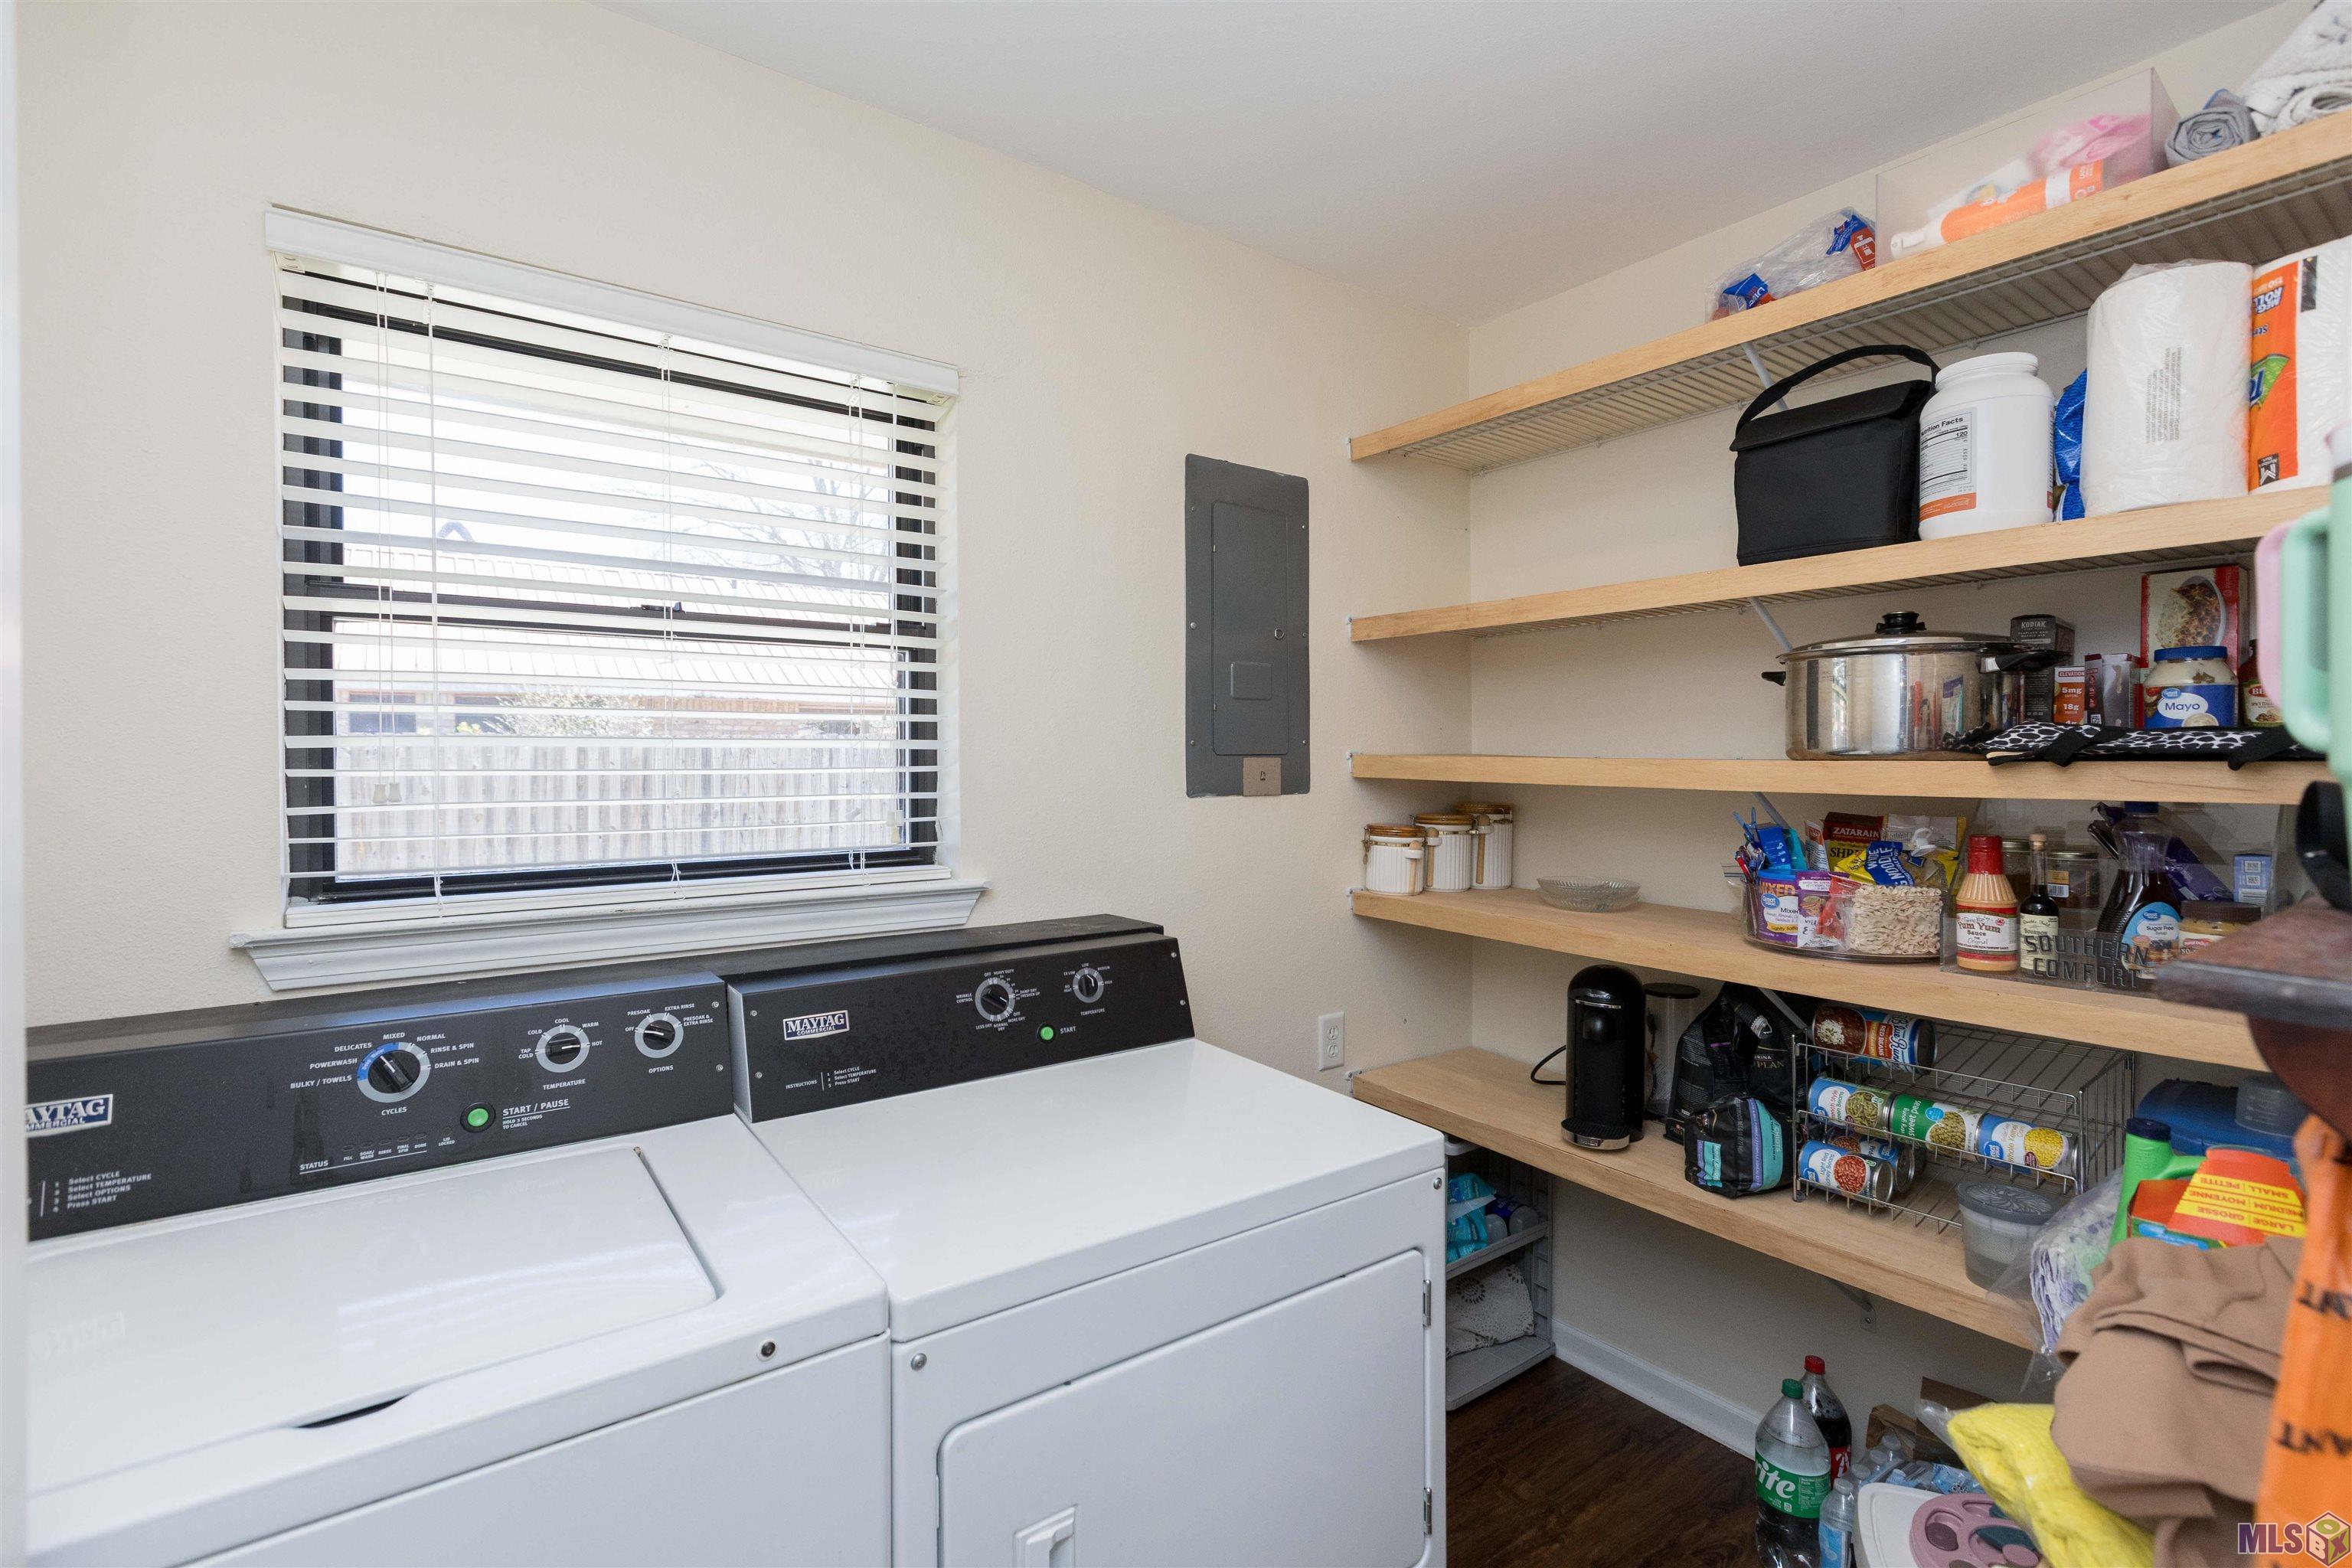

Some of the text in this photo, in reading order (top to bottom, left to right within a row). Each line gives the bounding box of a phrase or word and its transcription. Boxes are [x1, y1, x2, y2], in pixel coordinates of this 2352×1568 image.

[1921, 416, 1964, 436] utrition Facts
[2165, 702, 2200, 711] Mayo
[1833, 827, 1880, 838] ZATARAIN
[1867, 848, 1880, 870] WIDE
[1880, 847, 1905, 882] NOODLE
[1977, 923, 2001, 933] Yum
[2024, 935, 2149, 967] SOUTHERN
[2033, 958, 2137, 988] COMFORT
[1080, 1008, 1105, 1016] TEMPERATURE
[786, 1013, 844, 1033] MAYTAG
[416, 1033, 446, 1042] NORMAL
[796, 1026, 836, 1036] COMMERCIAL
[334, 1042, 372, 1053] DELICATES
[458, 1042, 475, 1050] SPIN
[309, 1057, 358, 1070] POWERWASH
[434, 1061, 456, 1070] DRAIN
[463, 1057, 479, 1066] SPIN
[648, 1064, 674, 1073] OPTIONS
[848, 1069, 877, 1078] TEMPERATURE
[290, 1080, 315, 1089] BULKY
[322, 1075, 352, 1085] TOWELS
[542, 1078, 586, 1090] TEMPERATURE
[786, 1080, 818, 1089] INSTRUCTIONS
[24, 1099, 105, 1124] AYTAG
[381, 1106, 407, 1116] CYCLES
[502, 1105, 531, 1116] START
[541, 1099, 569, 1109] PAUSE
[1912, 1099, 1922, 1114] peas
[1902, 1107, 1910, 1122] young
[26, 1117, 86, 1132] MMERCIAL
[299, 1160, 328, 1171] STATUS
[68, 1174, 152, 1193] Select TEMPERATURE
[69, 1171, 120, 1184] Select CYCLE
[67, 1184, 131, 1201] Select OPTIONS
[2200, 1176, 2289, 1199] SMALL PETITE
[67, 1194, 117, 1210] Press START
[2189, 1190, 2246, 1206] MOYENNE
[2197, 1207, 2295, 1231] LARGE GROSSE
[1755, 1460, 1796, 1499] rite
